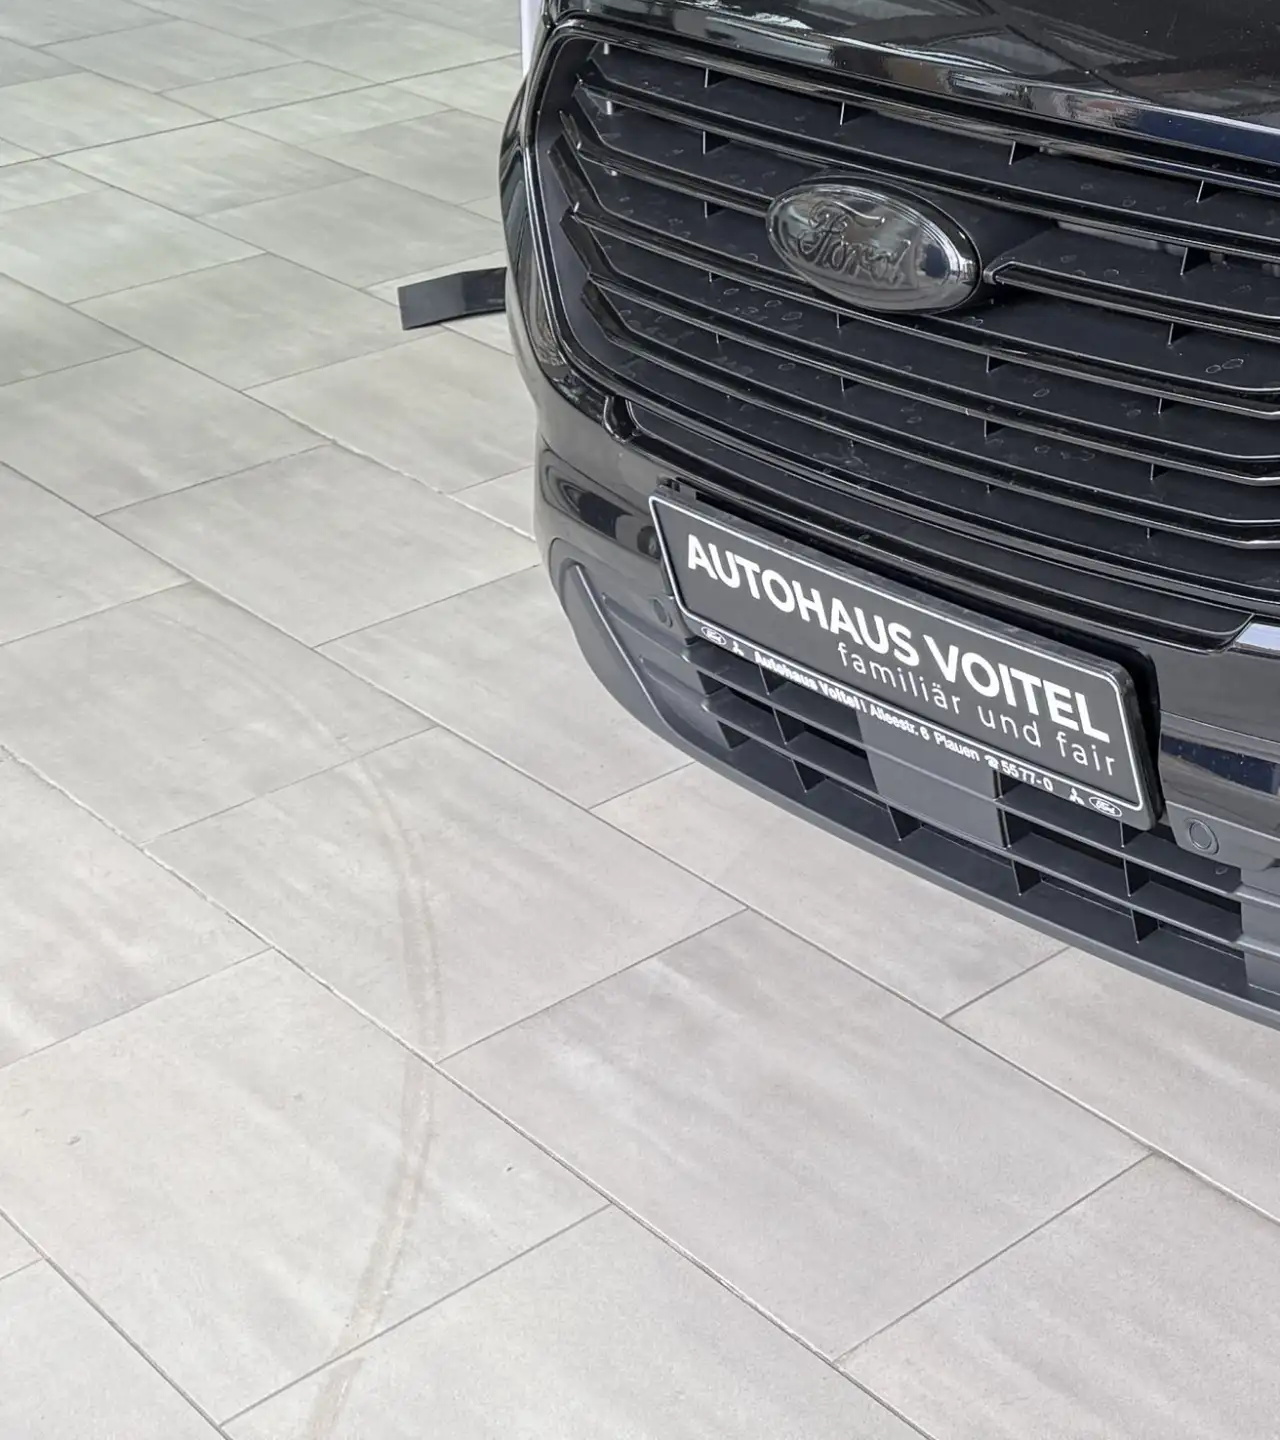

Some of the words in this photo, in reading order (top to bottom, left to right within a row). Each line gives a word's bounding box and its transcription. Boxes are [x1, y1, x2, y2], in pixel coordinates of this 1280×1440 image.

[687, 534, 920, 666] AUTOHAUS
[924, 634, 1111, 743] VOITEL
[837, 641, 961, 715] familiär
[977, 705, 1042, 748] und
[1056, 731, 1116, 776] fair
